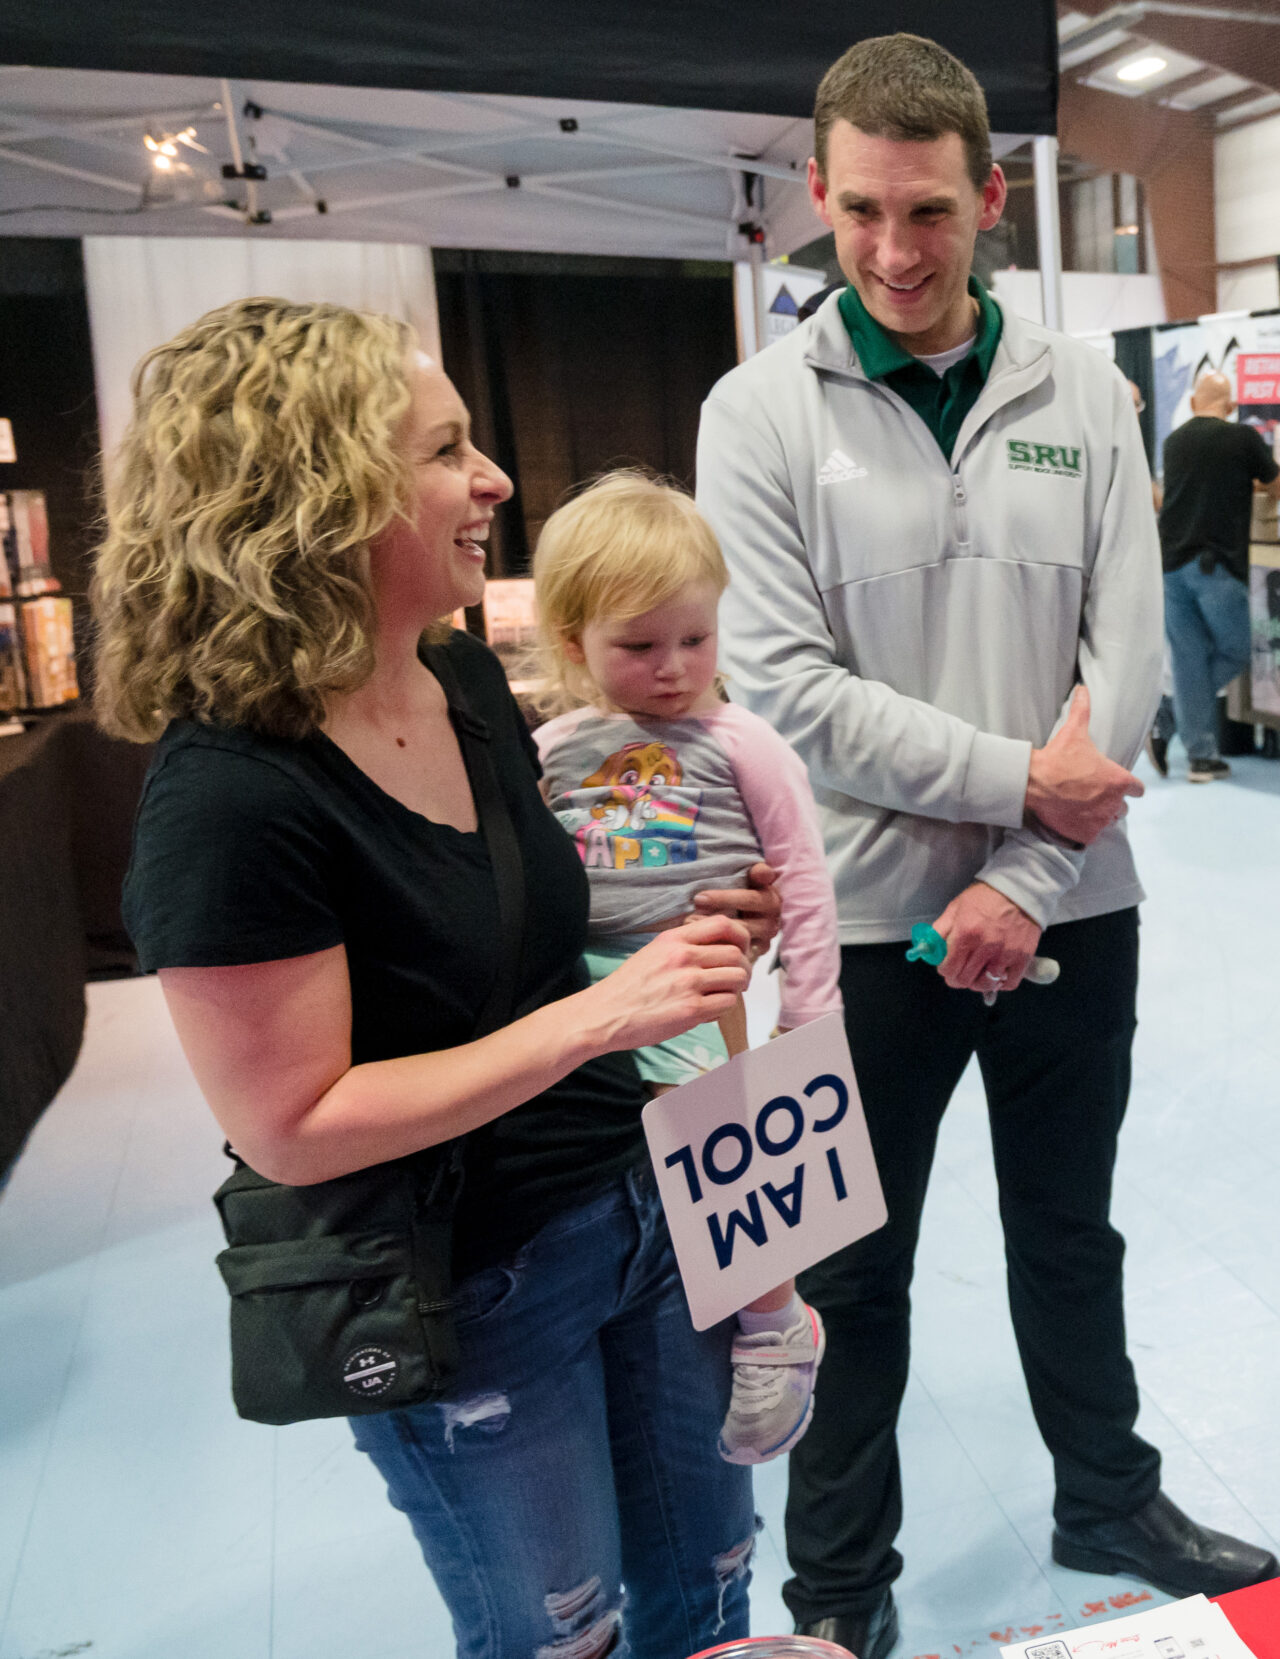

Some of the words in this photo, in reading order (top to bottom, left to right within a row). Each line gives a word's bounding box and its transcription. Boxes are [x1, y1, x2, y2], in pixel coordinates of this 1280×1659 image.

[1243, 381, 1275, 399] PEST
[1007, 440, 1081, 471] SRU
[664, 1073, 849, 1204] COOL
[826, 1147, 848, 1202] I
[706, 1163, 805, 1271] AM
